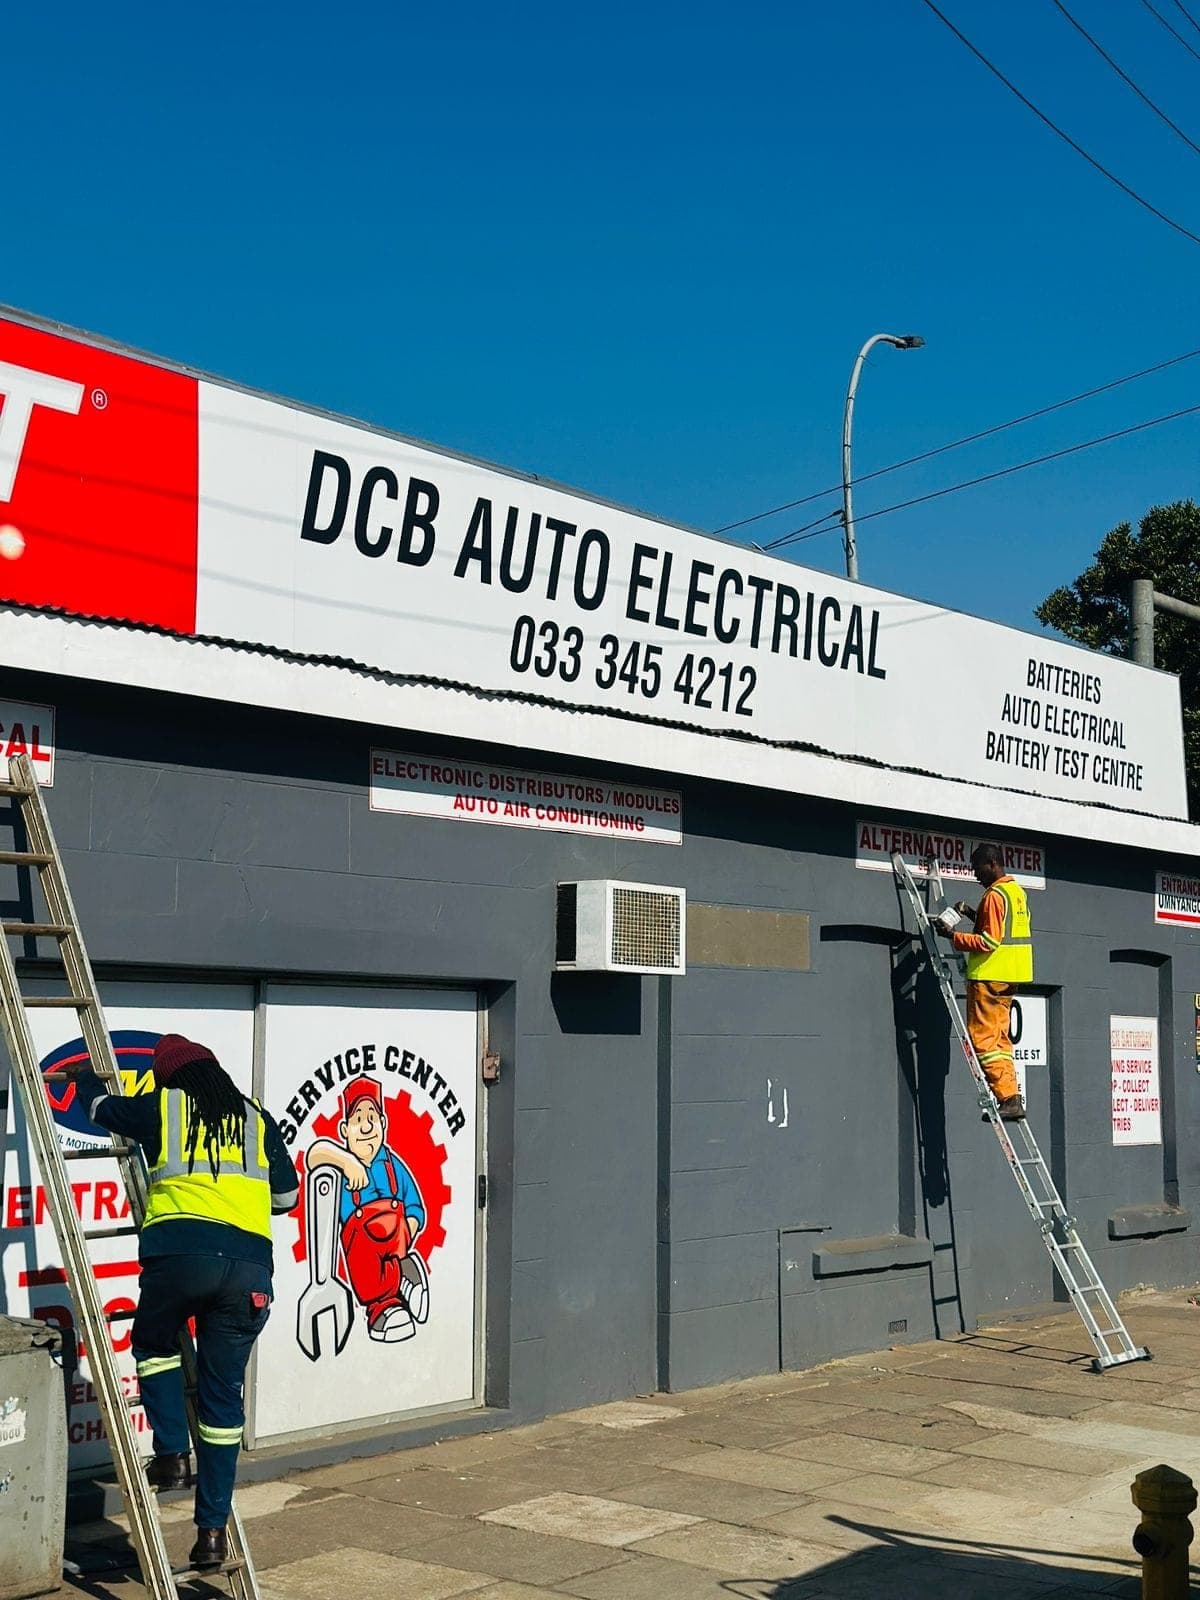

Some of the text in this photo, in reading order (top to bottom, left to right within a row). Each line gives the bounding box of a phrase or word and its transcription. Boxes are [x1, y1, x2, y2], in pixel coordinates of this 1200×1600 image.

[301, 450, 887, 680] DCB AUTO ELECTRICAL
[510, 615, 757, 716] 033 345 4212
[1026, 659, 1101, 704] BATTERIES
[0, 722, 50, 762] AL
[1001, 693, 1126, 749] AUTO ELECTRICAL
[986, 731, 1143, 791] BATTERY TEST CENTRE
[372, 757, 484, 788] ELECTRONIC
[489, 774, 604, 804] DISTRIBUTORS
[613, 790, 680, 815] MODULES
[453, 793, 645, 832] AUTO AIR CONDITIONING
[859, 825, 965, 862] ALTERNATOR
[1013, 1050, 1041, 1060] ELE ST
[1127, 1060, 1152, 1073] SERVICE
[281, 1044, 466, 1145] SERVICE CENTER
[1122, 1079, 1149, 1093] COLLECT
[1133, 1098, 1159, 1112] DELIVER
